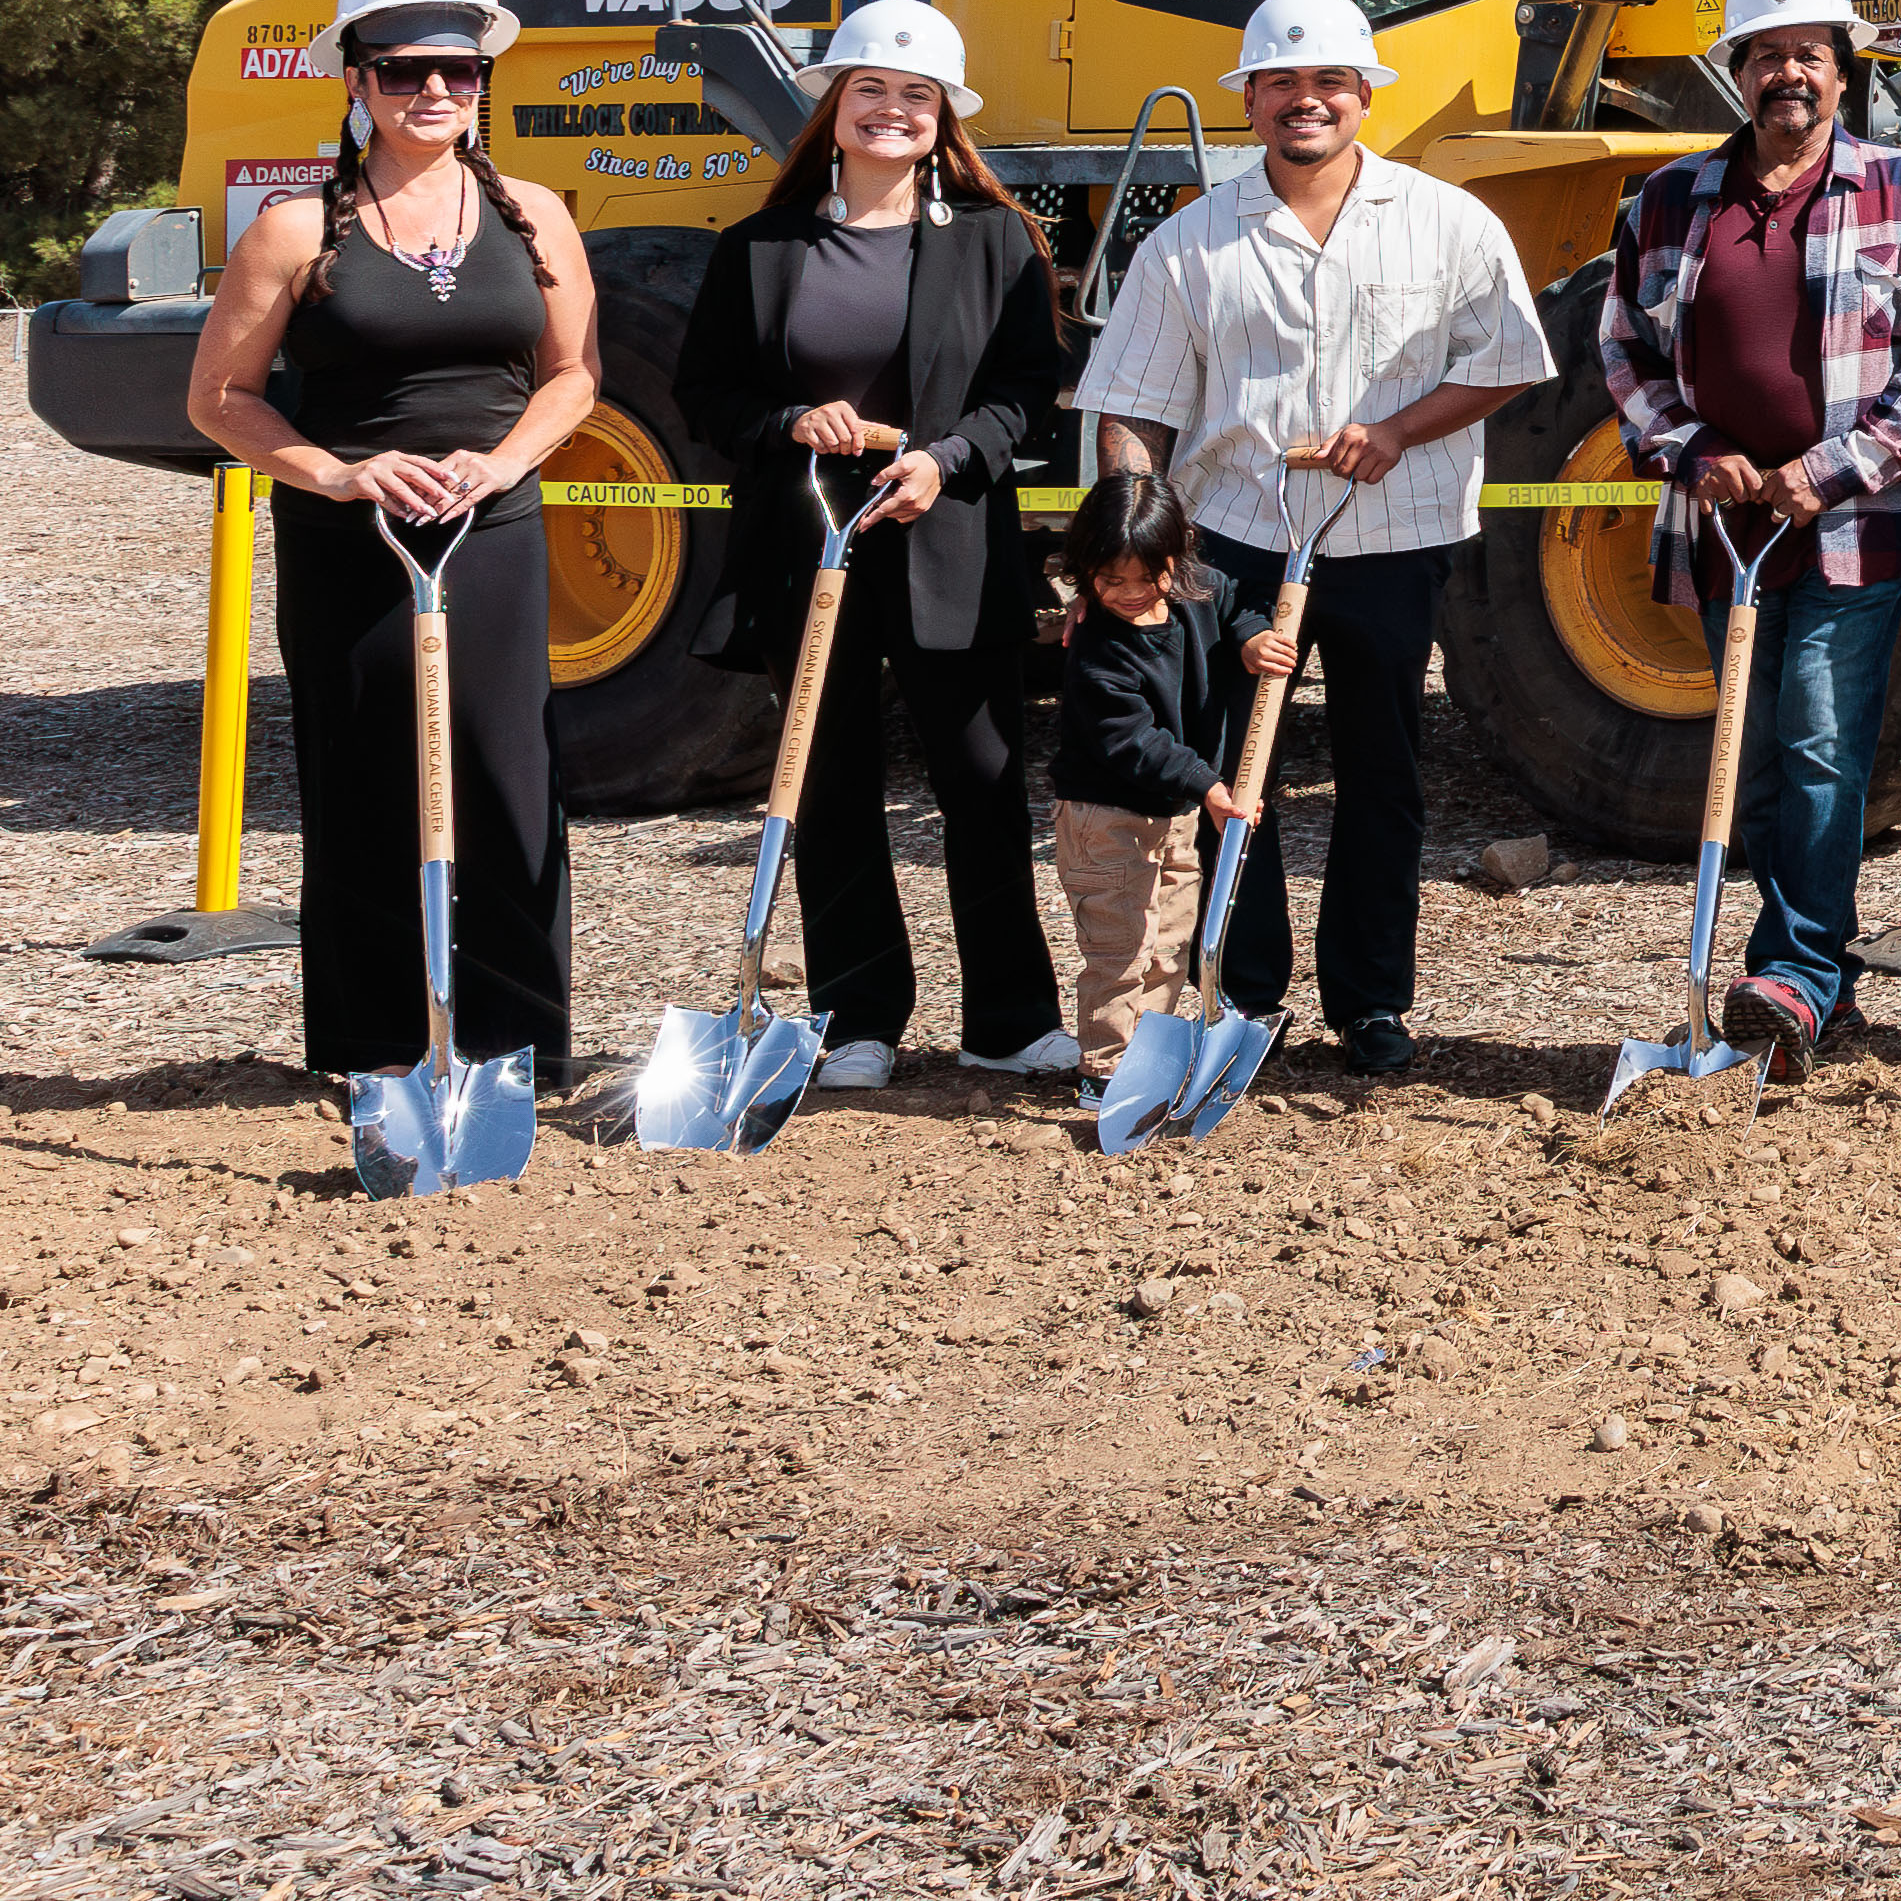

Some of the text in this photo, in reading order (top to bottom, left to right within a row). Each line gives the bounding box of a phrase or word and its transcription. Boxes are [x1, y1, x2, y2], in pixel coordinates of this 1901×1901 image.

[640, 55, 681, 83] Dug
[513, 103, 625, 137] WHILLOCK
[256, 165, 335, 184] DANGER
[586, 148, 648, 178] Since
[654, 154, 691, 179] the
[567, 486, 655, 505] CAUTION
[683, 488, 710, 506] DO
[779, 620, 826, 789] SYCUAN MEDICAL CENTER
[425, 664, 444, 834] SYCUAN MEDICAL CENTER
[1238, 682, 1271, 789] MEDICAL CENTER
[1711, 654, 1741, 818] SYCUAN MEDICAL CENTER
